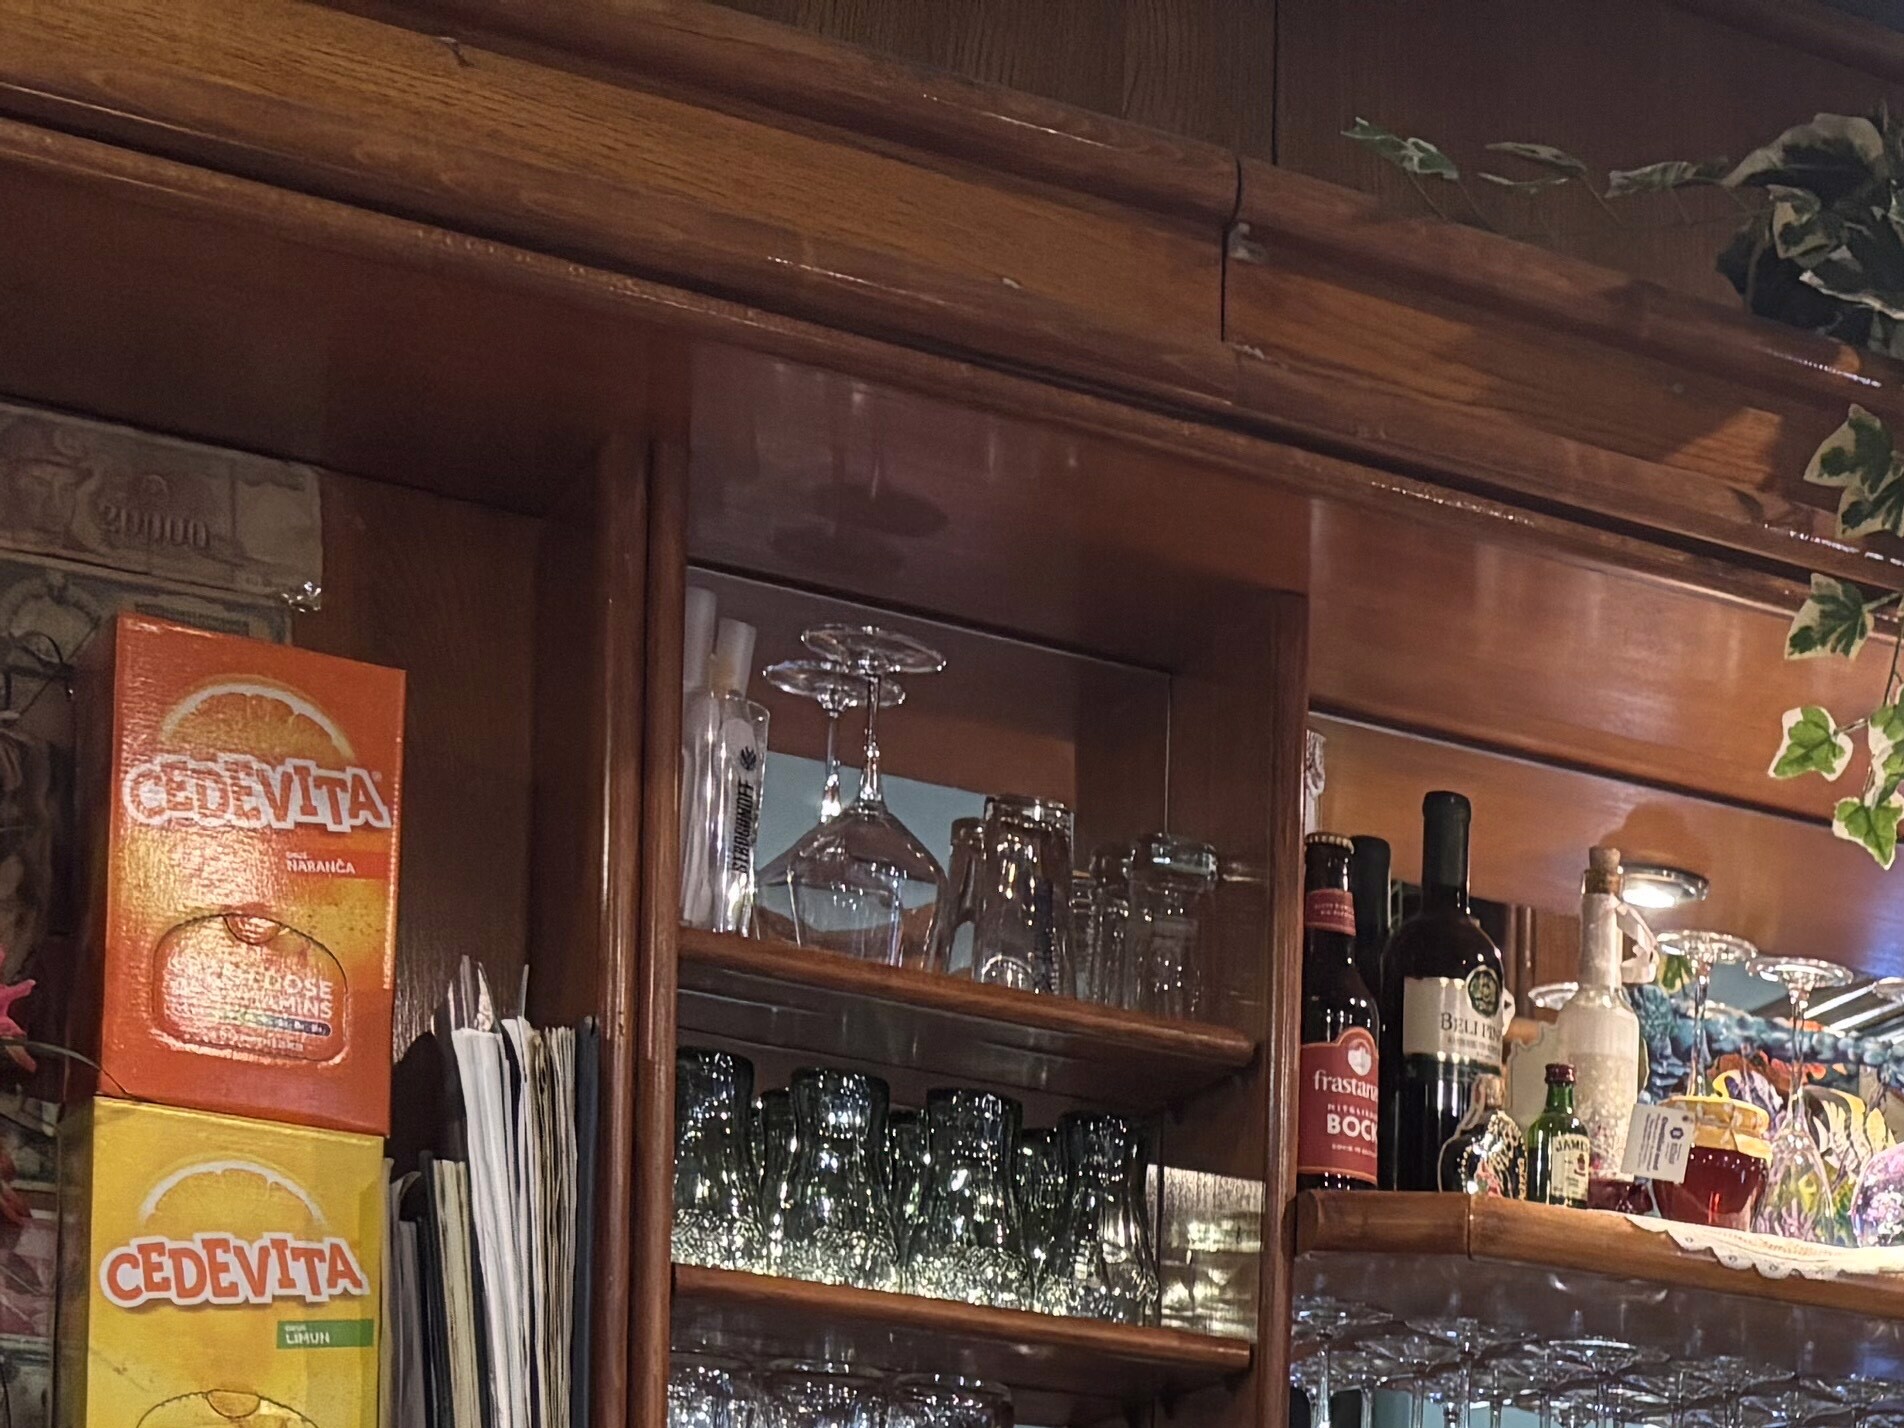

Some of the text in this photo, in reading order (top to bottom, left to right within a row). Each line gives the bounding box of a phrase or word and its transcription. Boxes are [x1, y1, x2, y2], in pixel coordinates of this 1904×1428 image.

[123, 753, 391, 831] CEDEVITA
[101, 1232, 370, 1307] CEDEVITA
[284, 1331, 331, 1345] LIMUN
